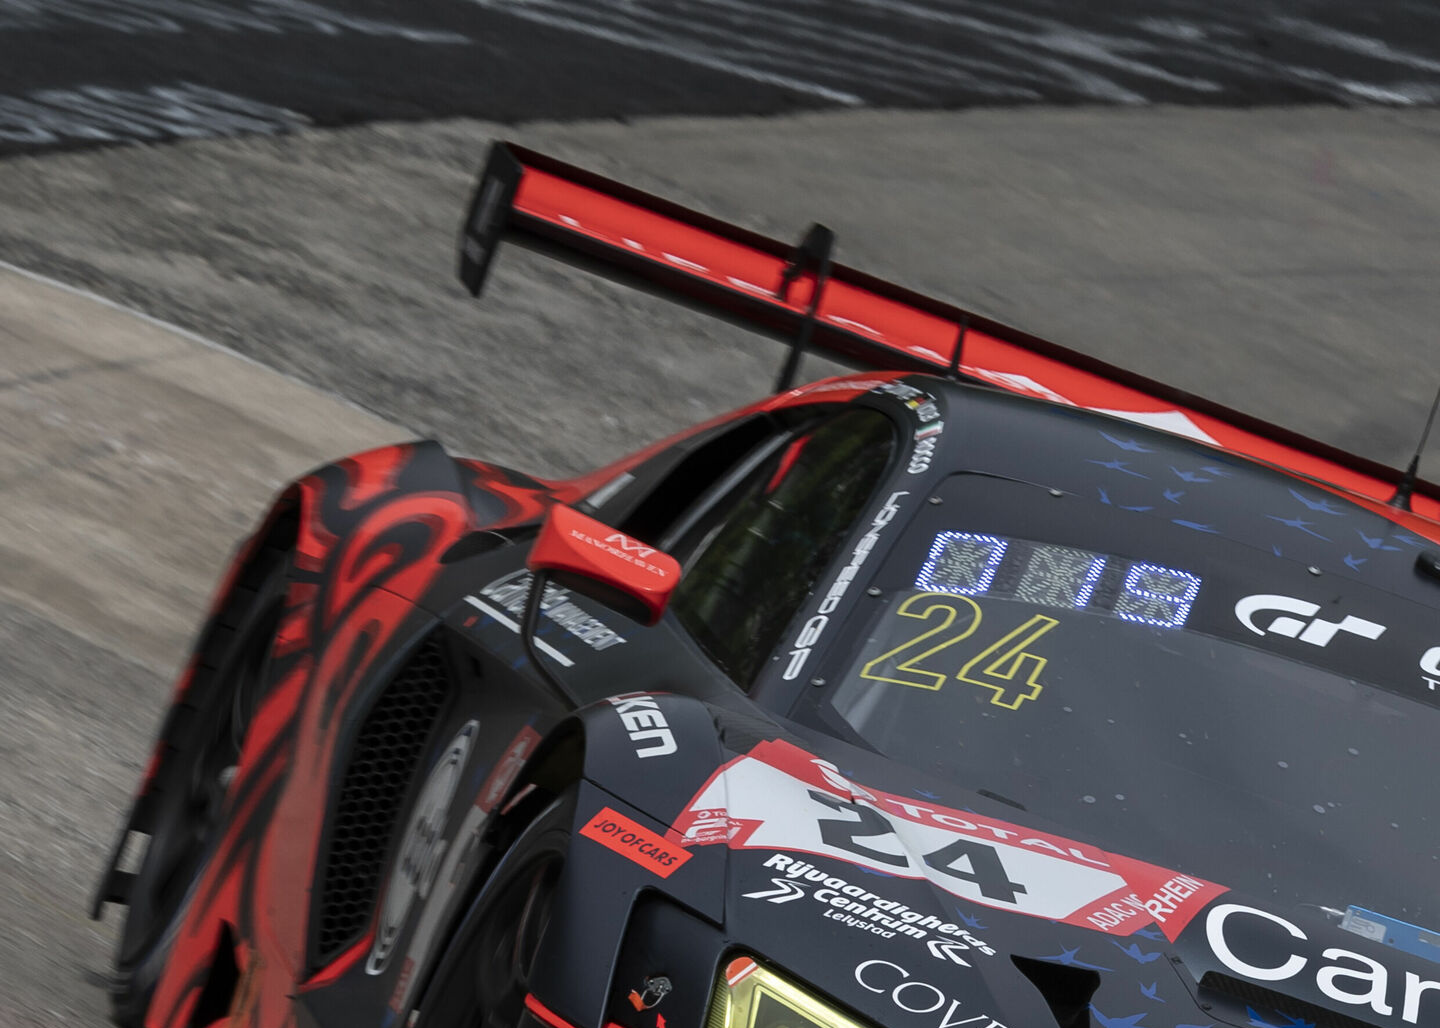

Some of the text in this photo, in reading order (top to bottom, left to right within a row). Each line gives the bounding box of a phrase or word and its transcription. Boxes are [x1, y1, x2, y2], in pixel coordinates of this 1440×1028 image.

[858, 592, 1060, 711] 24
[807, 788, 1028, 905] 24
[886, 798, 1111, 868] TOTAL
[812, 888, 928, 939] Centrum
[823, 909, 897, 940] Lelystad
[1086, 902, 1137, 931] ADAC
[1143, 874, 1205, 923] RHEIN
